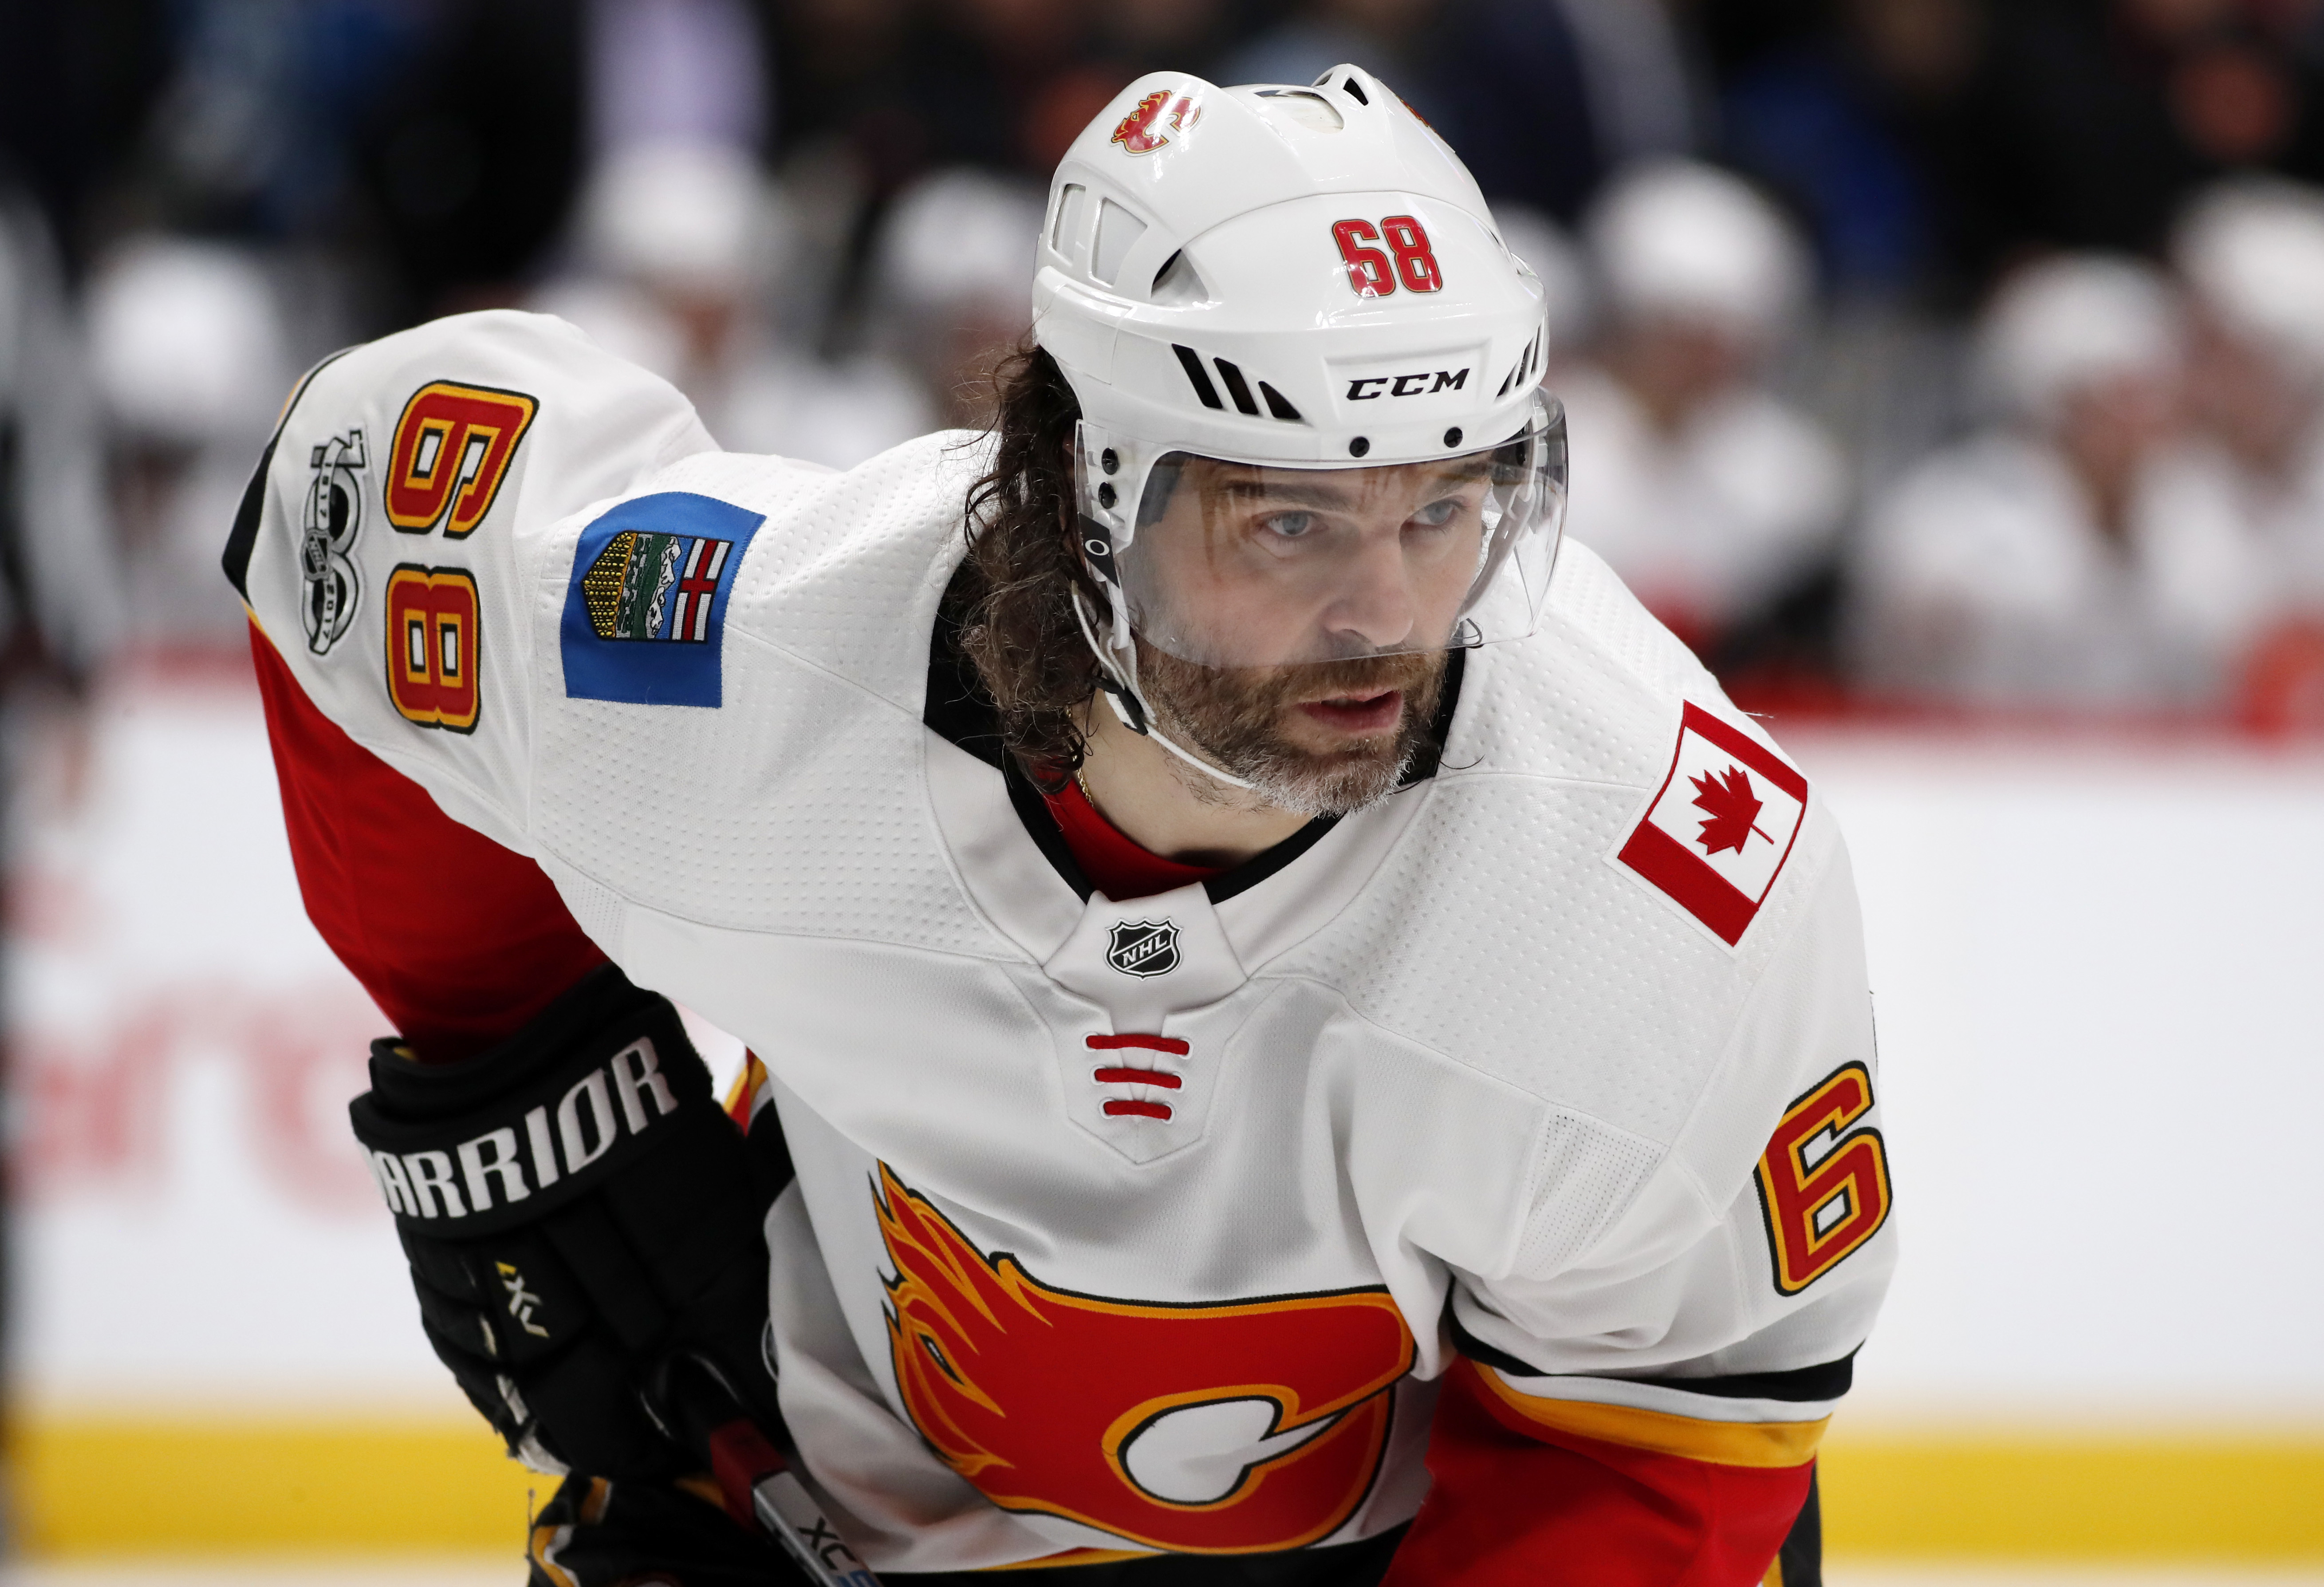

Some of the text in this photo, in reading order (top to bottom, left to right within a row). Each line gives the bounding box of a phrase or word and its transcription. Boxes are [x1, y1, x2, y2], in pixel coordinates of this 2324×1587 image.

[1331, 216, 1442, 298] 68
[1346, 368, 1470, 401] CCM
[383, 379, 540, 735] 68
[323, 584, 335, 640] 2017
[1122, 933, 1168, 967] NHL
